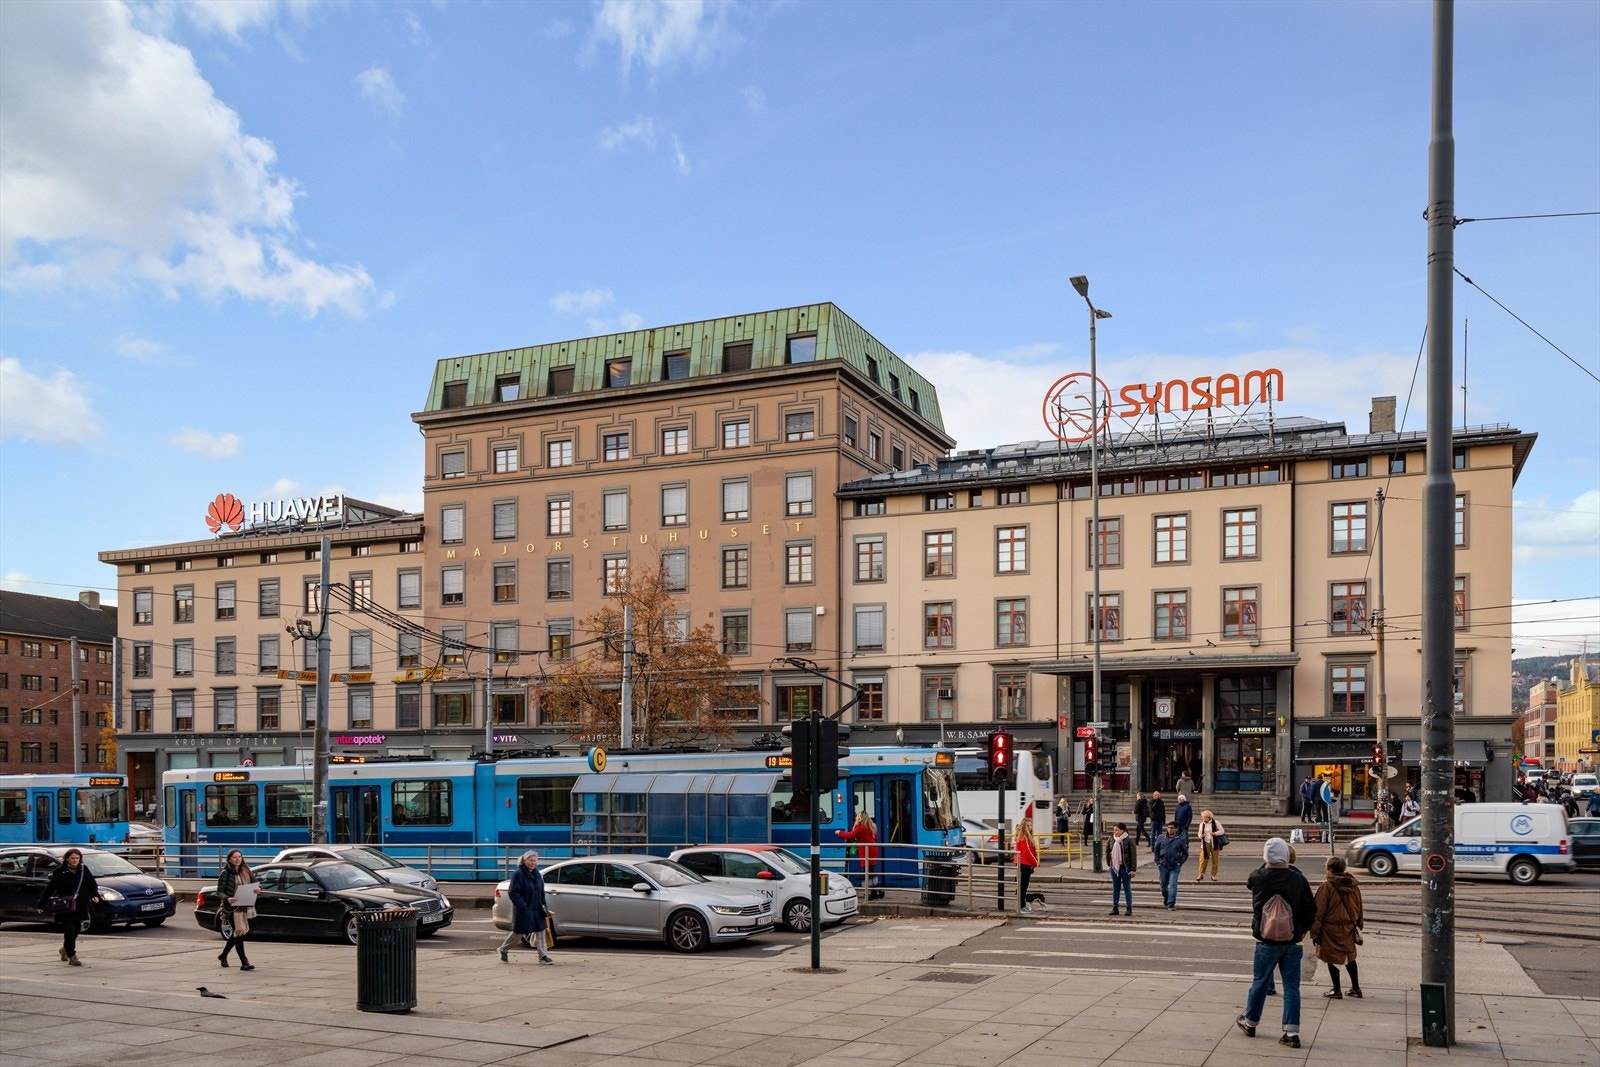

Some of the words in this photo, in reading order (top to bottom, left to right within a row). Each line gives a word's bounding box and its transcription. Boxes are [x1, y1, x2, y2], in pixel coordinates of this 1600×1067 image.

[1119, 368, 1284, 418] SYNSAM
[250, 494, 345, 524] HUAWEI
[446, 521, 803, 559] MAJORSTUHUSET
[946, 731, 957, 739] W.
[958, 731, 966, 739] B.
[1173, 730, 1203, 738] Majorstue
[175, 738, 214, 746] KROGH
[226, 737, 278, 746] OPTIKK
[499, 735, 518, 743] VITA
[768, 757, 777, 766] 19
